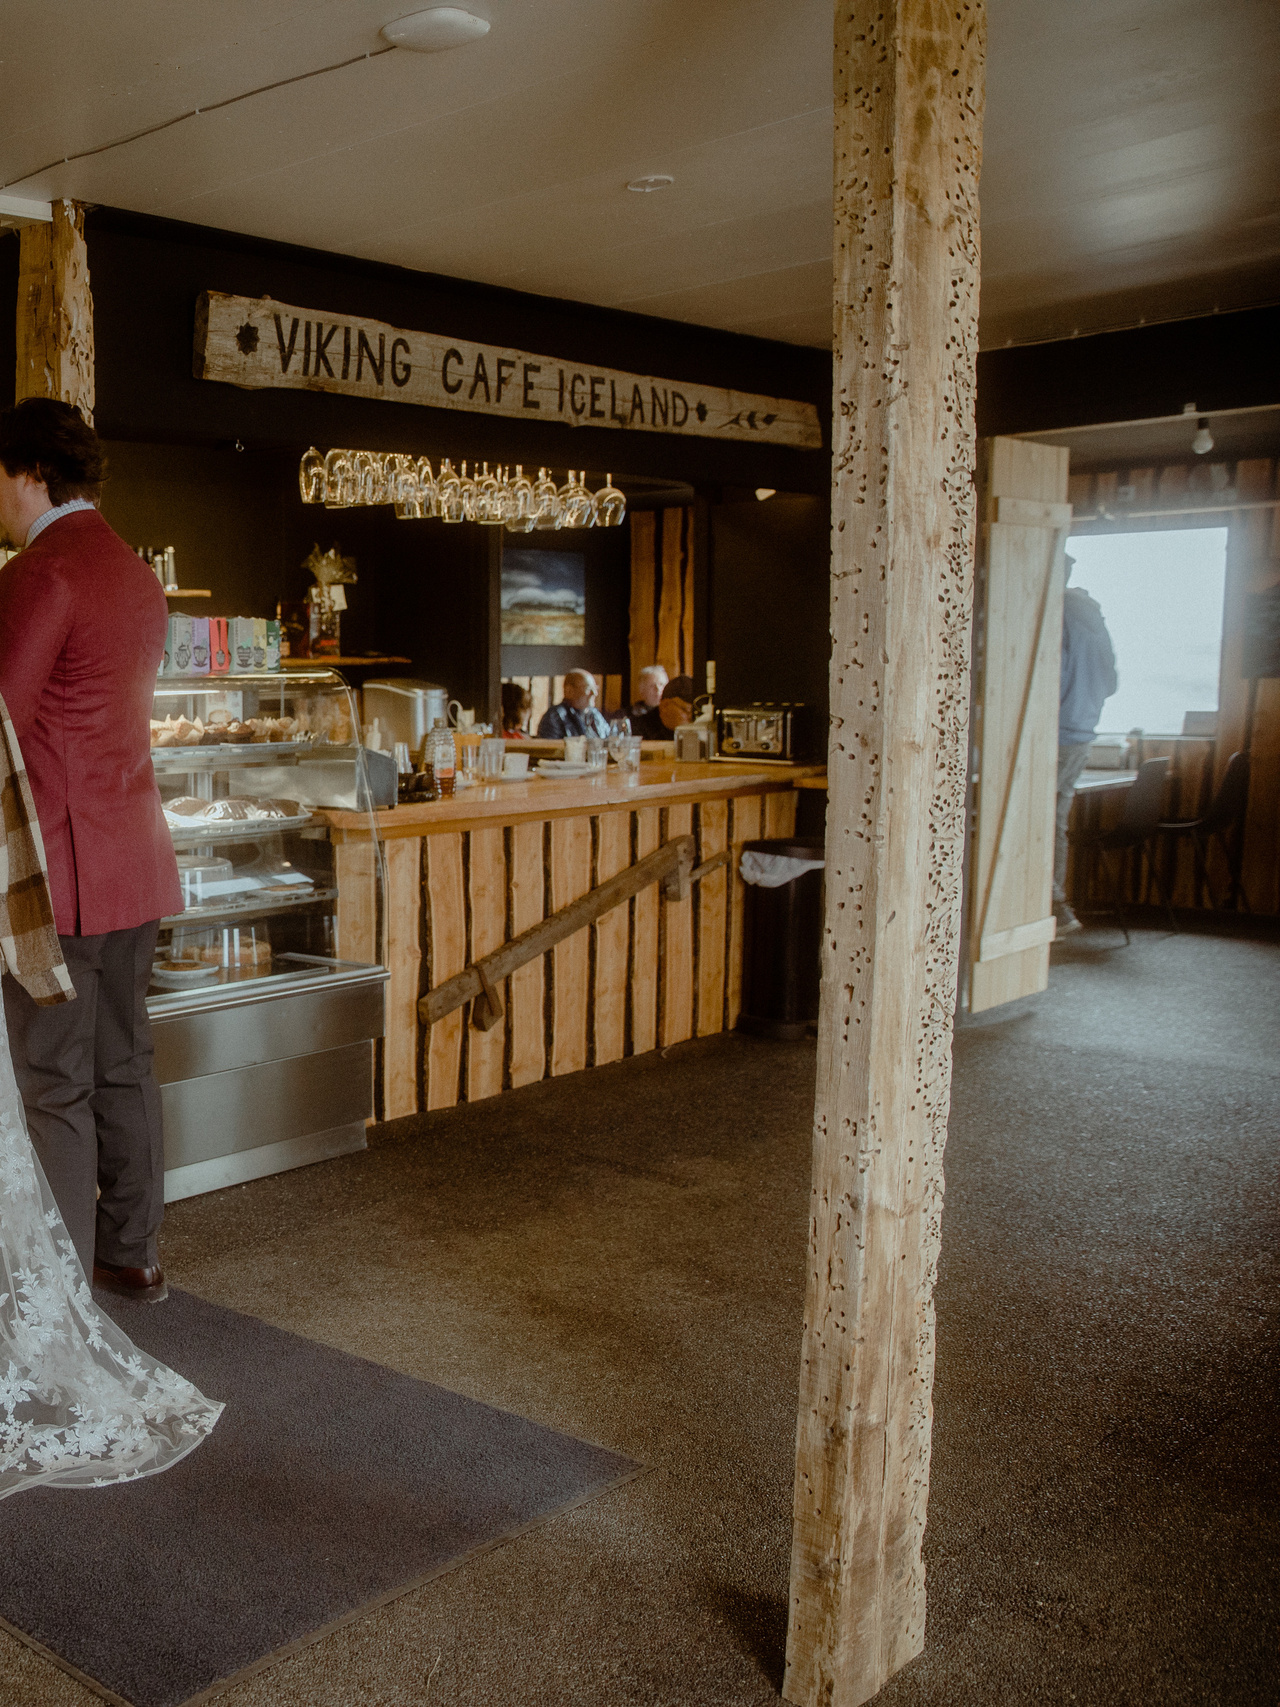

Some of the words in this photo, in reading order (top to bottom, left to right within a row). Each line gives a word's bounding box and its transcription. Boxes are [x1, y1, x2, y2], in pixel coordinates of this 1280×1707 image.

[273, 312, 412, 389] VIKING
[441, 347, 542, 409] CAFE
[557, 367, 690, 428] ICELAND
